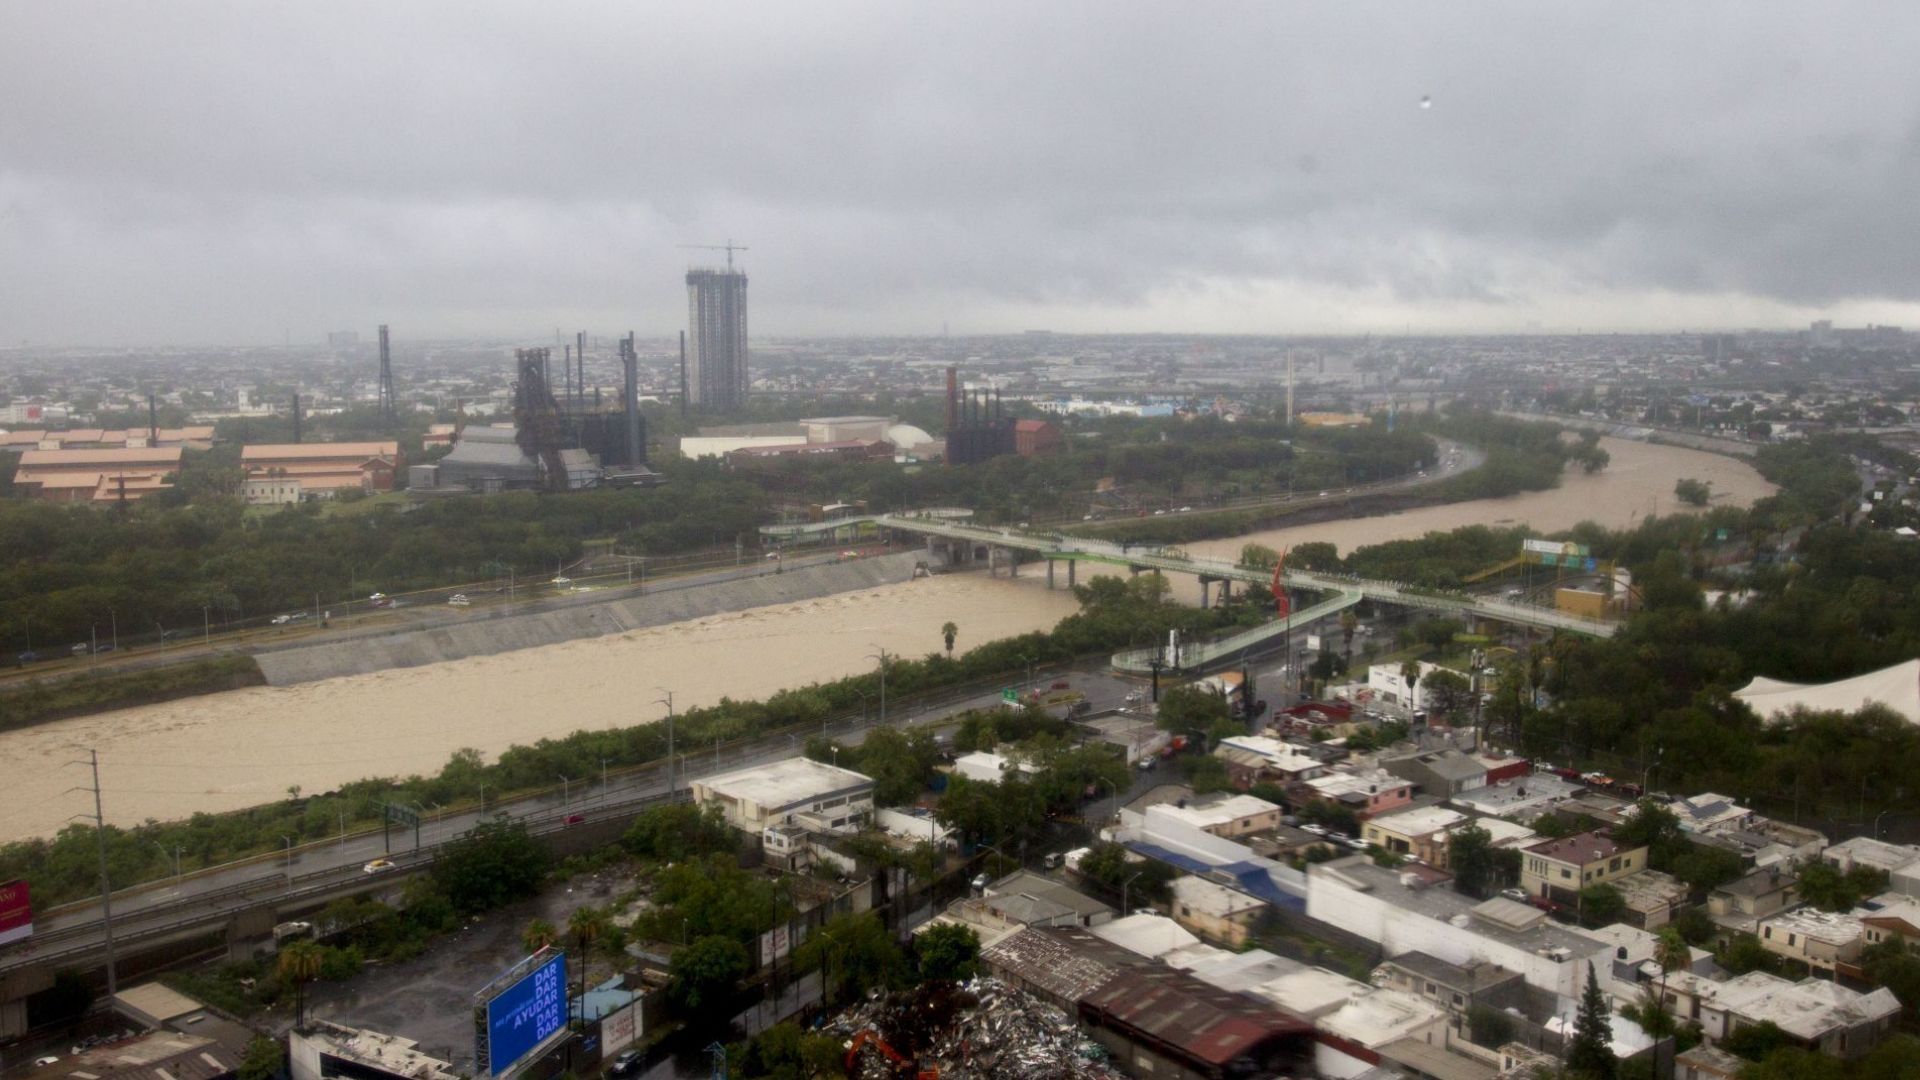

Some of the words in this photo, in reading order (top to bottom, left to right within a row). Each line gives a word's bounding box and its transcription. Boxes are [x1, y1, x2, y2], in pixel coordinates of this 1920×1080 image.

[535, 963, 557, 987] DAR
[536, 976, 557, 999] DAR
[514, 989, 558, 1029] AYUDAR
[537, 1004, 559, 1028] DAR
[537, 1016, 559, 1041] DAR
